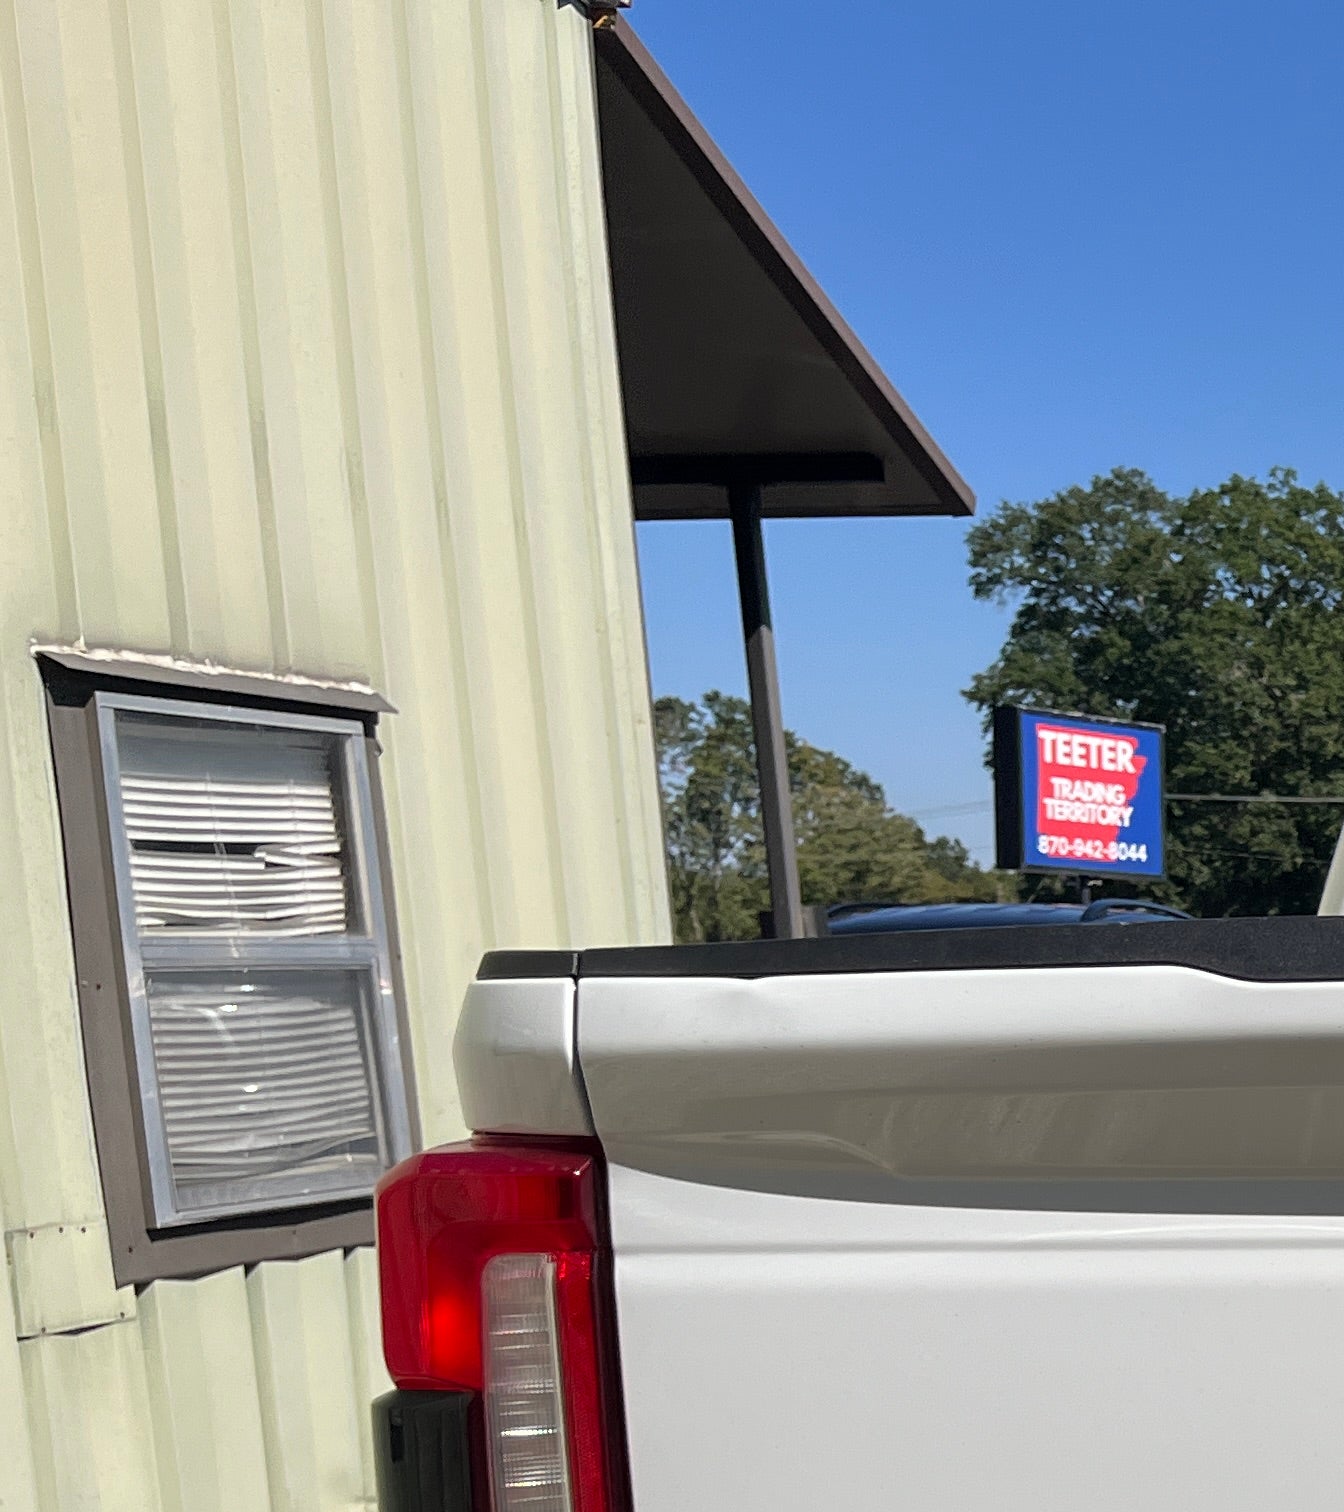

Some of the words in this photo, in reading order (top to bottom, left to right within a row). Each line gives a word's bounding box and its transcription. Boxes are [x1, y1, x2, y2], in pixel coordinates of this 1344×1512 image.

[1037, 730, 1135, 773] TEETER
[1050, 777, 1126, 805] TRADING
[1043, 797, 1134, 827] TERRITORY
[1037, 835, 1148, 862] 870-942-8044
